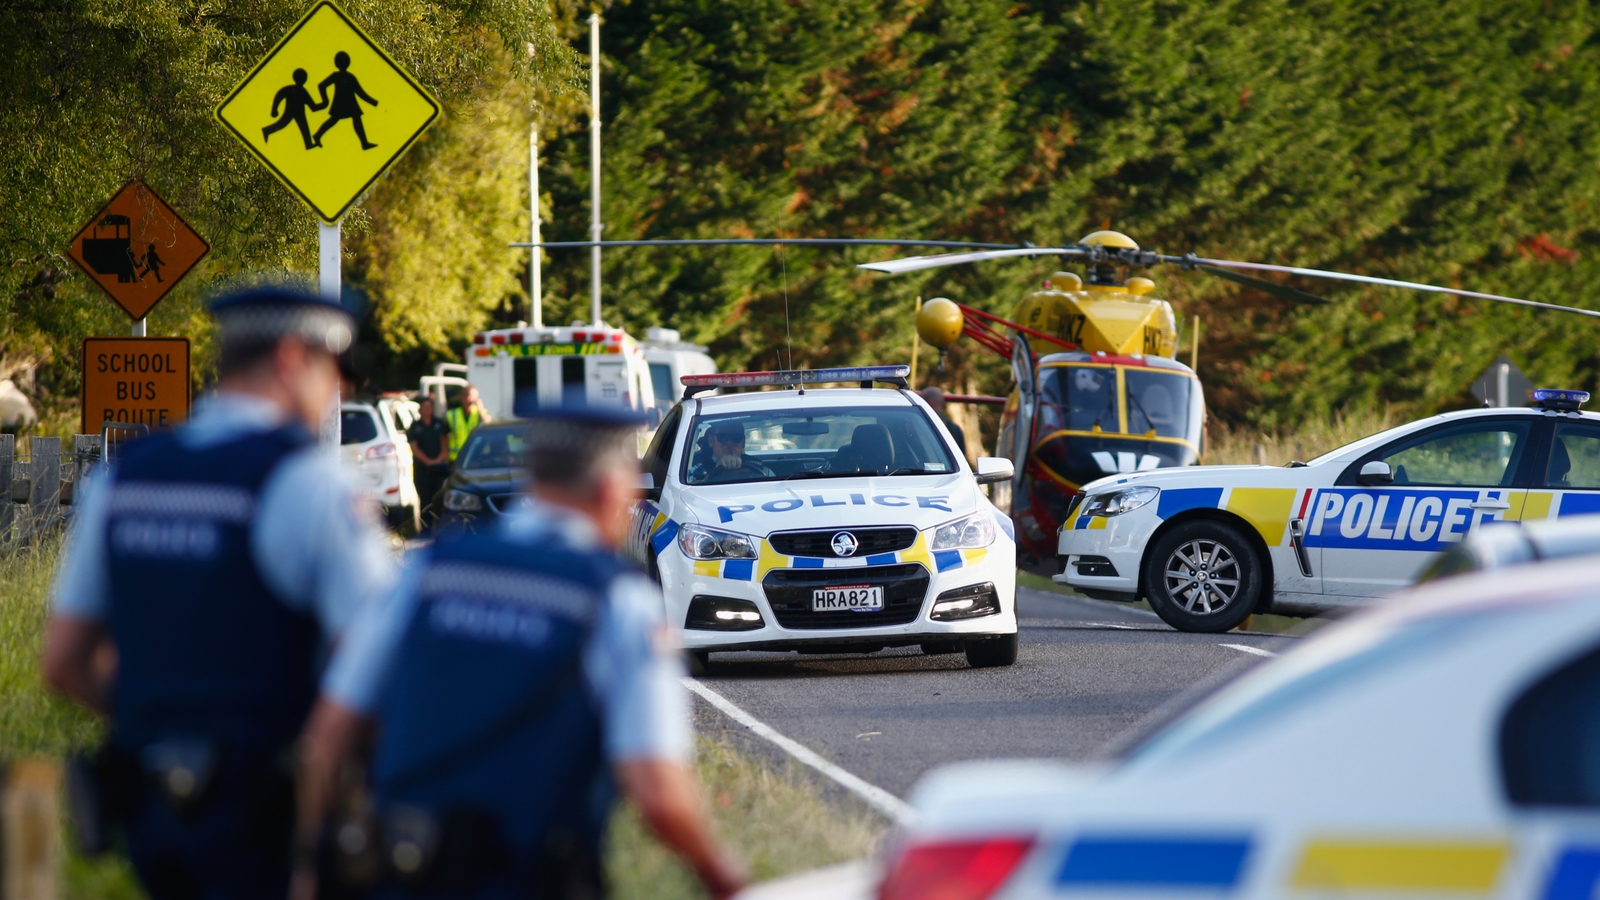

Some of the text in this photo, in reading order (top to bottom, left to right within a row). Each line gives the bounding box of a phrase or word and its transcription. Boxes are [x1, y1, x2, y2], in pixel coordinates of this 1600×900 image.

[97, 353, 176, 373] SCHOOL
[117, 381, 156, 401] BUS
[103, 408, 169, 428] ROUTE
[717, 493, 953, 524] POLICE
[1309, 492, 1474, 543] POLICE
[815, 589, 878, 608] HRA821
